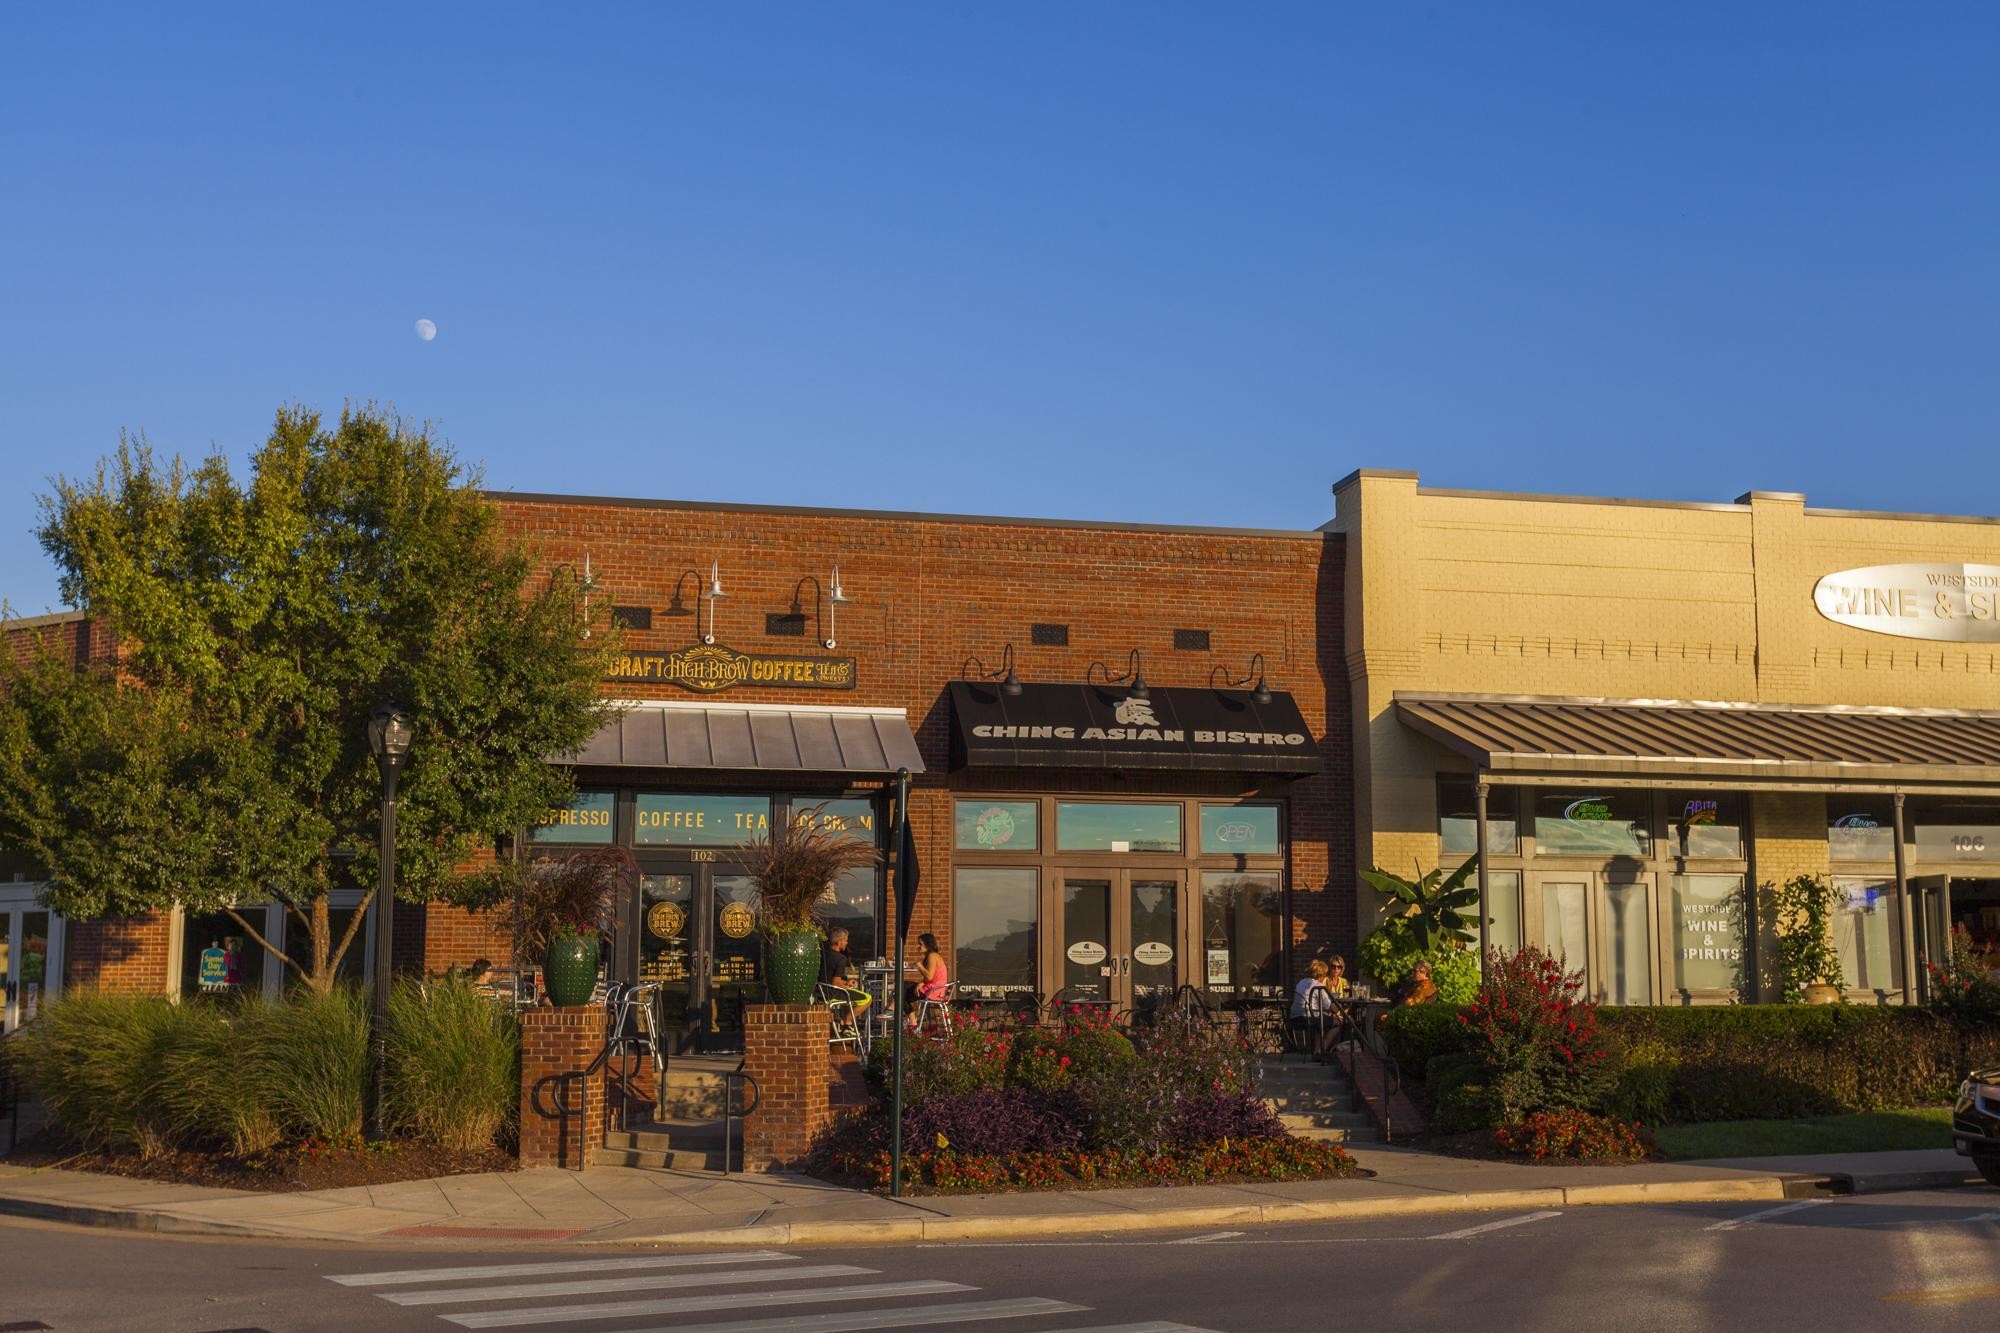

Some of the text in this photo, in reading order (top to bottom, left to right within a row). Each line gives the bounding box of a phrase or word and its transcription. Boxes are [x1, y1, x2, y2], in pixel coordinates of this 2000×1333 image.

[1829, 586, 1920, 618] WINE
[1934, 591, 1952, 620] &
[608, 656, 665, 677] CRAFT
[751, 659, 814, 682] COFFEE
[972, 725, 1305, 745] CHING ASIAN BISTRO
[535, 809, 609, 826] SPRESSO
[639, 811, 705, 828] COFFEE
[735, 813, 767, 830] TEA
[823, 815, 872, 831] CRM
[1217, 825, 1257, 841] OPEN
[1951, 835, 1985, 851] 106
[693, 850, 713, 861] 102
[1682, 904, 1732, 913] WESTSIDE
[1687, 920, 1728, 932] WINE
[1703, 934, 1713, 946] &
[960, 985, 1034, 993] CHINE UISINE
[1209, 985, 1235, 993] SUSHI
